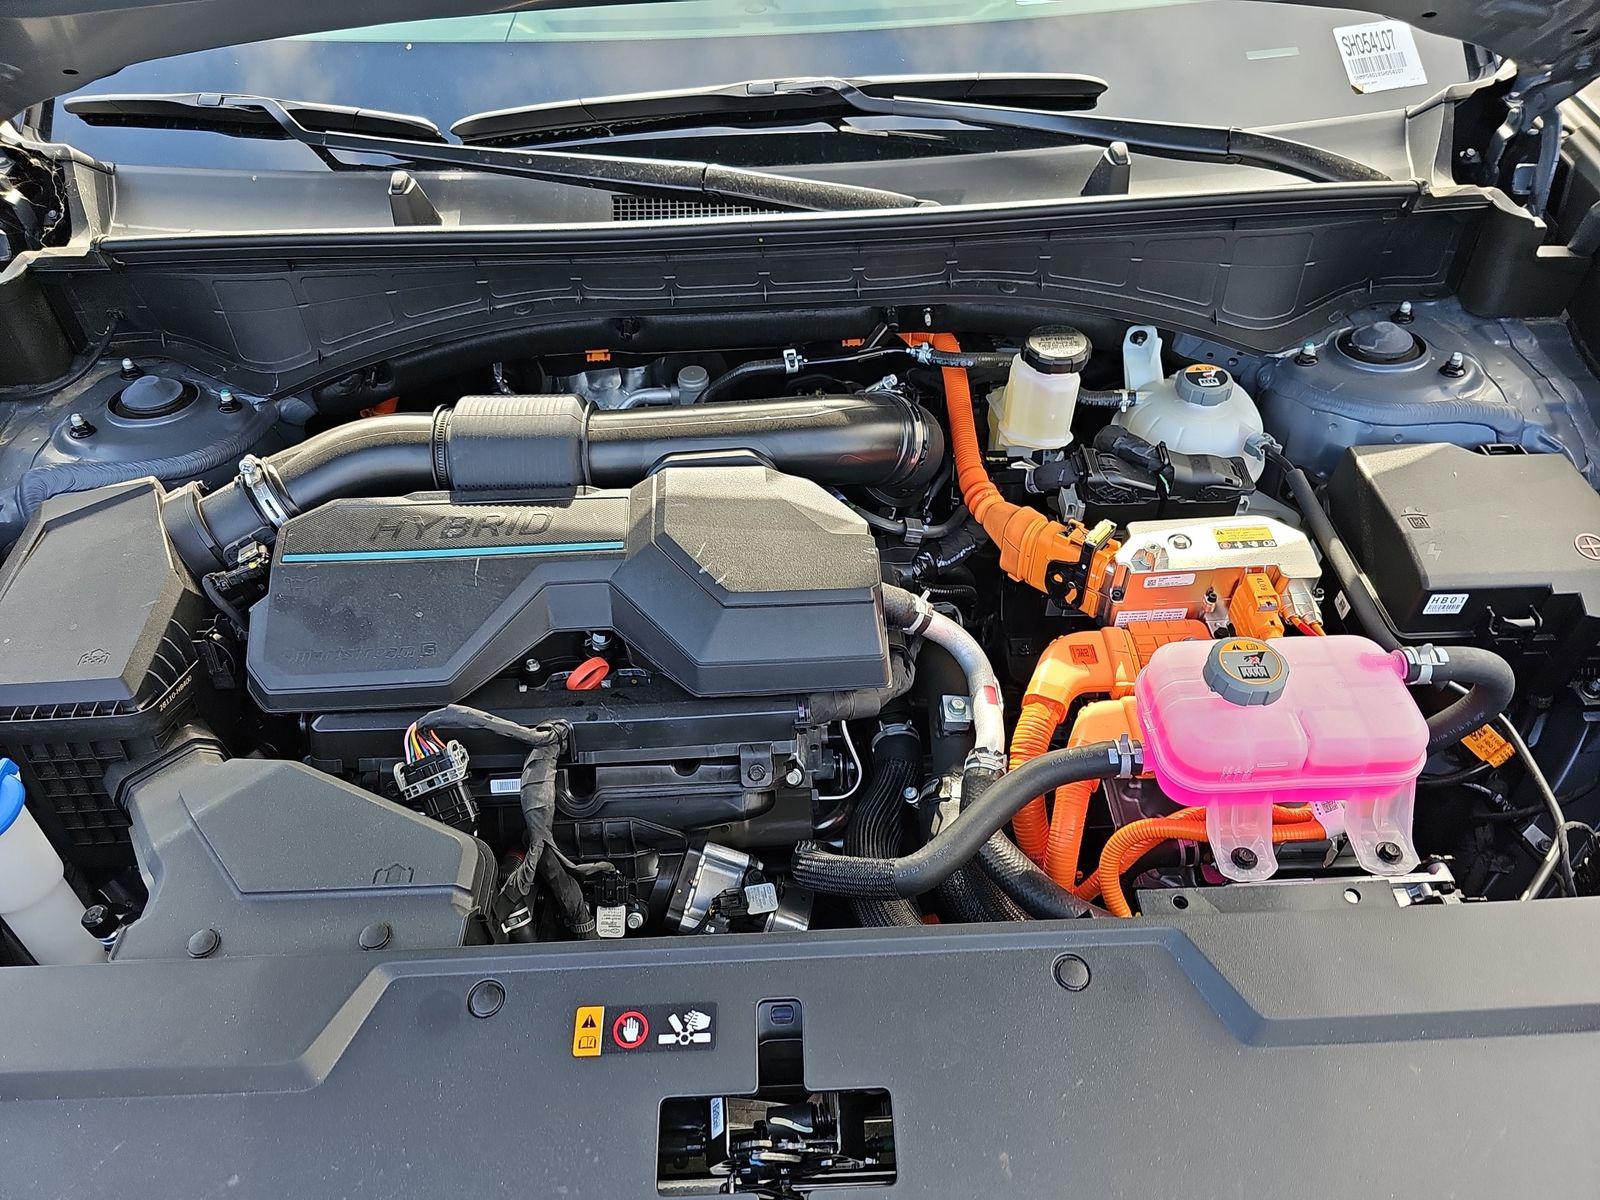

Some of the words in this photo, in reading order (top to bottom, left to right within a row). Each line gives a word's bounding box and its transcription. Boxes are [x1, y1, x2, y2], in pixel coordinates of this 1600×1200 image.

[1341, 28, 1396, 57] SH054107
[370, 510, 554, 542] HYBRID
[1430, 596, 1466, 605] HB01
